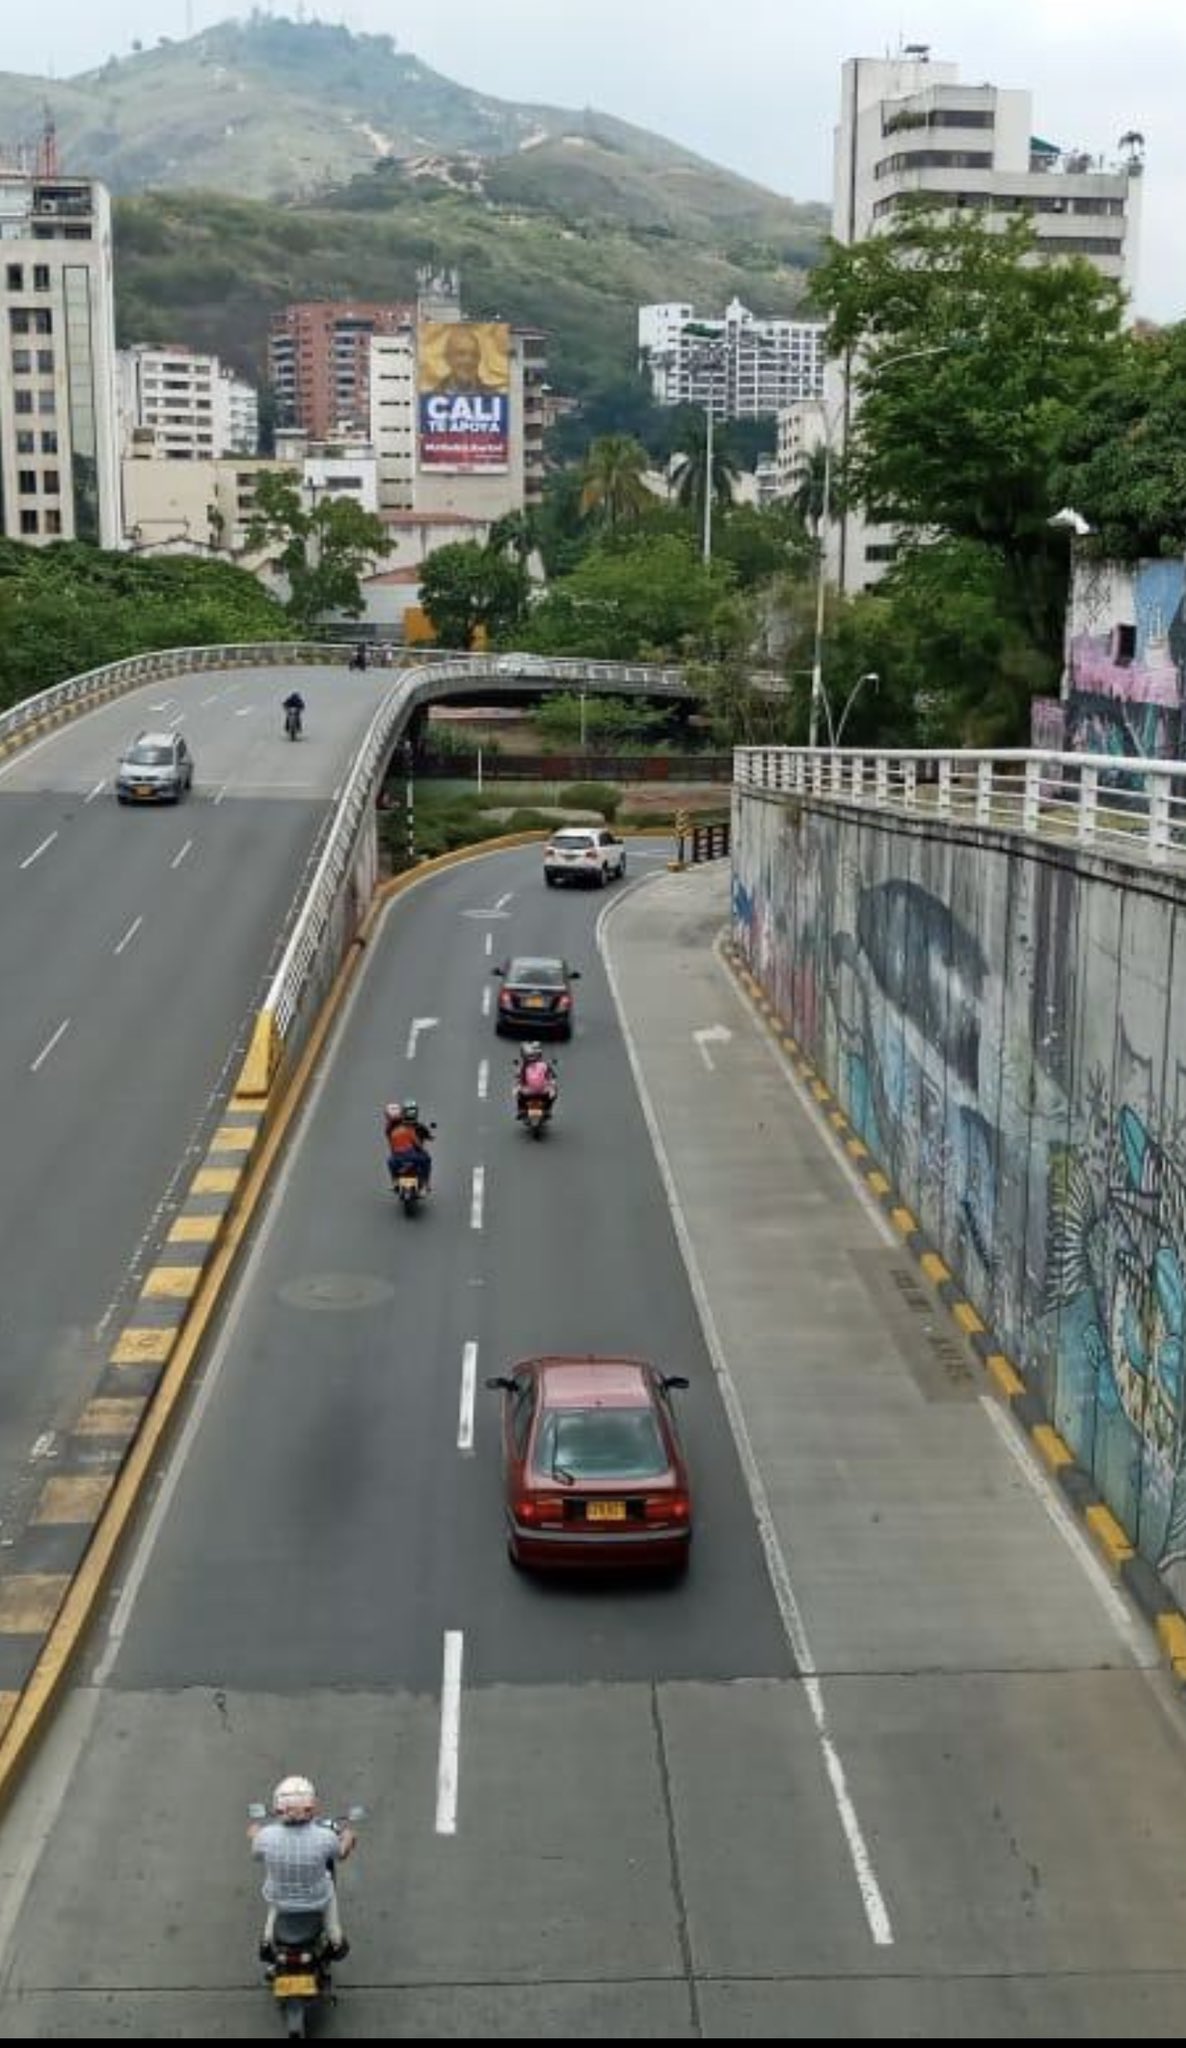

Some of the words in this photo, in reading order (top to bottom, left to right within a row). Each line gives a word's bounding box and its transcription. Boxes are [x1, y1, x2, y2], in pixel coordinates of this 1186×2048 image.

[428, 396, 501, 420] CALI
[428, 420, 446, 433] TE
[449, 420, 501, 432] APOYA
